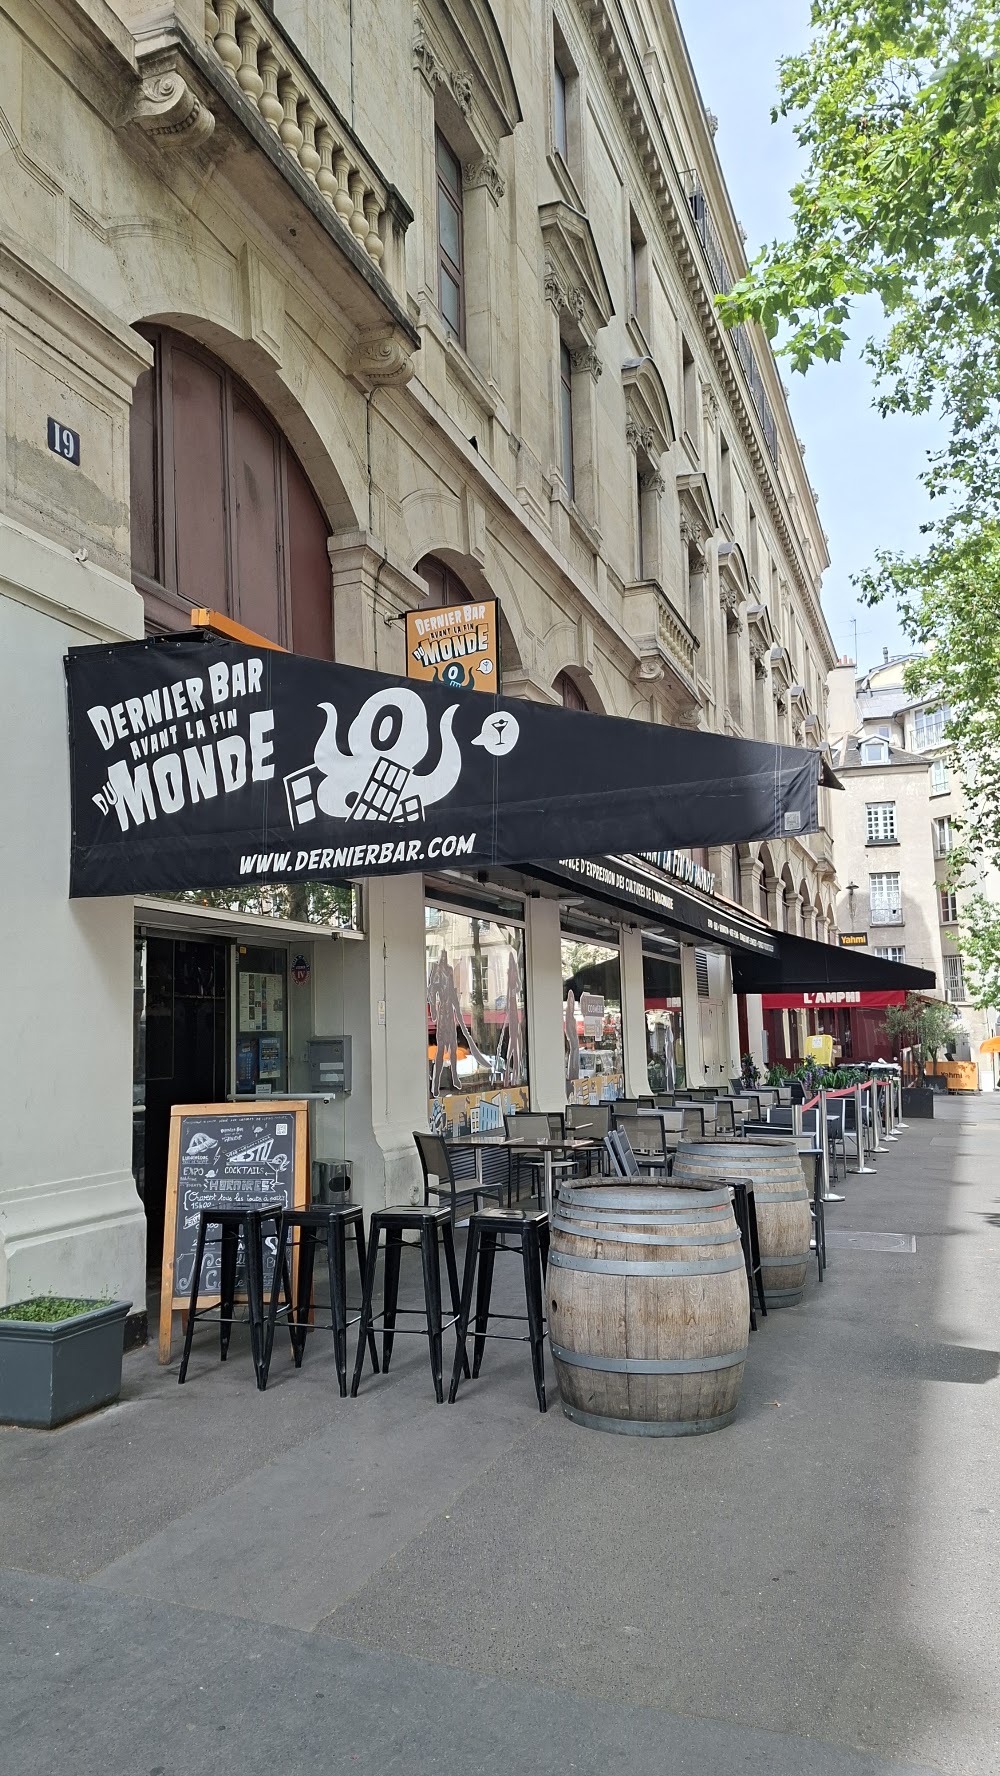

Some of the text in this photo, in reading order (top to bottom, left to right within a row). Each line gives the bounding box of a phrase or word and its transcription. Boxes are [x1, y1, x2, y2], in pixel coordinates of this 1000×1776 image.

[54, 422, 74, 458] 19
[415, 605, 486, 635] DERNIER BAR
[430, 623, 474, 640] AVANT LA FIN
[412, 623, 489, 667] DU MONDE
[87, 657, 264, 751] DERNIER BAR
[129, 708, 239, 761] AVANT LA FIN
[91, 709, 277, 832] DU MONDE
[238, 833, 477, 875] WWW.DERNIERBAR.COM
[841, 935, 867, 945] Yahmi
[803, 991, 861, 1004] L'AMPHI
[224, 1166, 264, 1175] COCKTAILS
